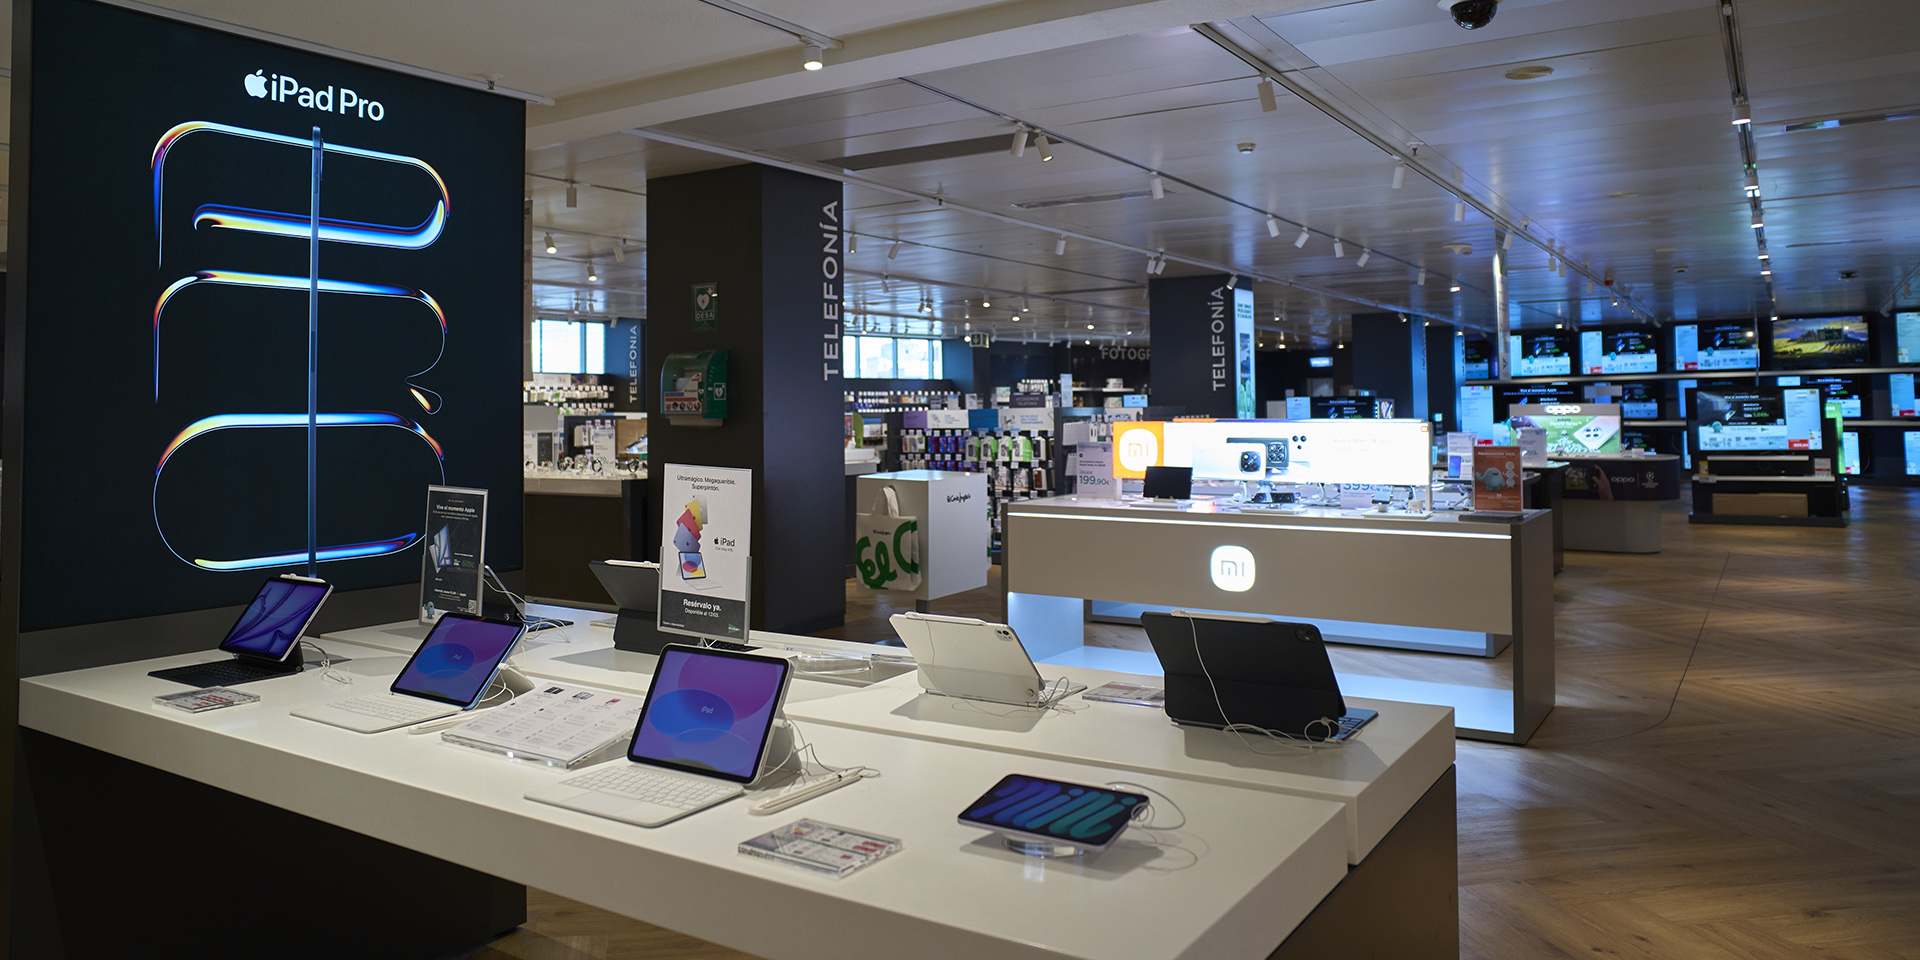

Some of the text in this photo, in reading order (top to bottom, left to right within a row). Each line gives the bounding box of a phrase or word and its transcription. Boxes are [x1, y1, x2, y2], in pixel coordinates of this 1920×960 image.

[271, 73, 385, 121] iPad Pro
[819, 200, 839, 381] TELEFONÍA
[695, 311, 714, 320] DESA
[1207, 286, 1226, 392] TELEFONÍA
[1079, 475, 1110, 486] 199,90€
[720, 537, 735, 547] iPad
[683, 598, 722, 612] Resérvalo ya.
[685, 608, 703, 616] Disponible
[700, 705, 715, 715] iPad
